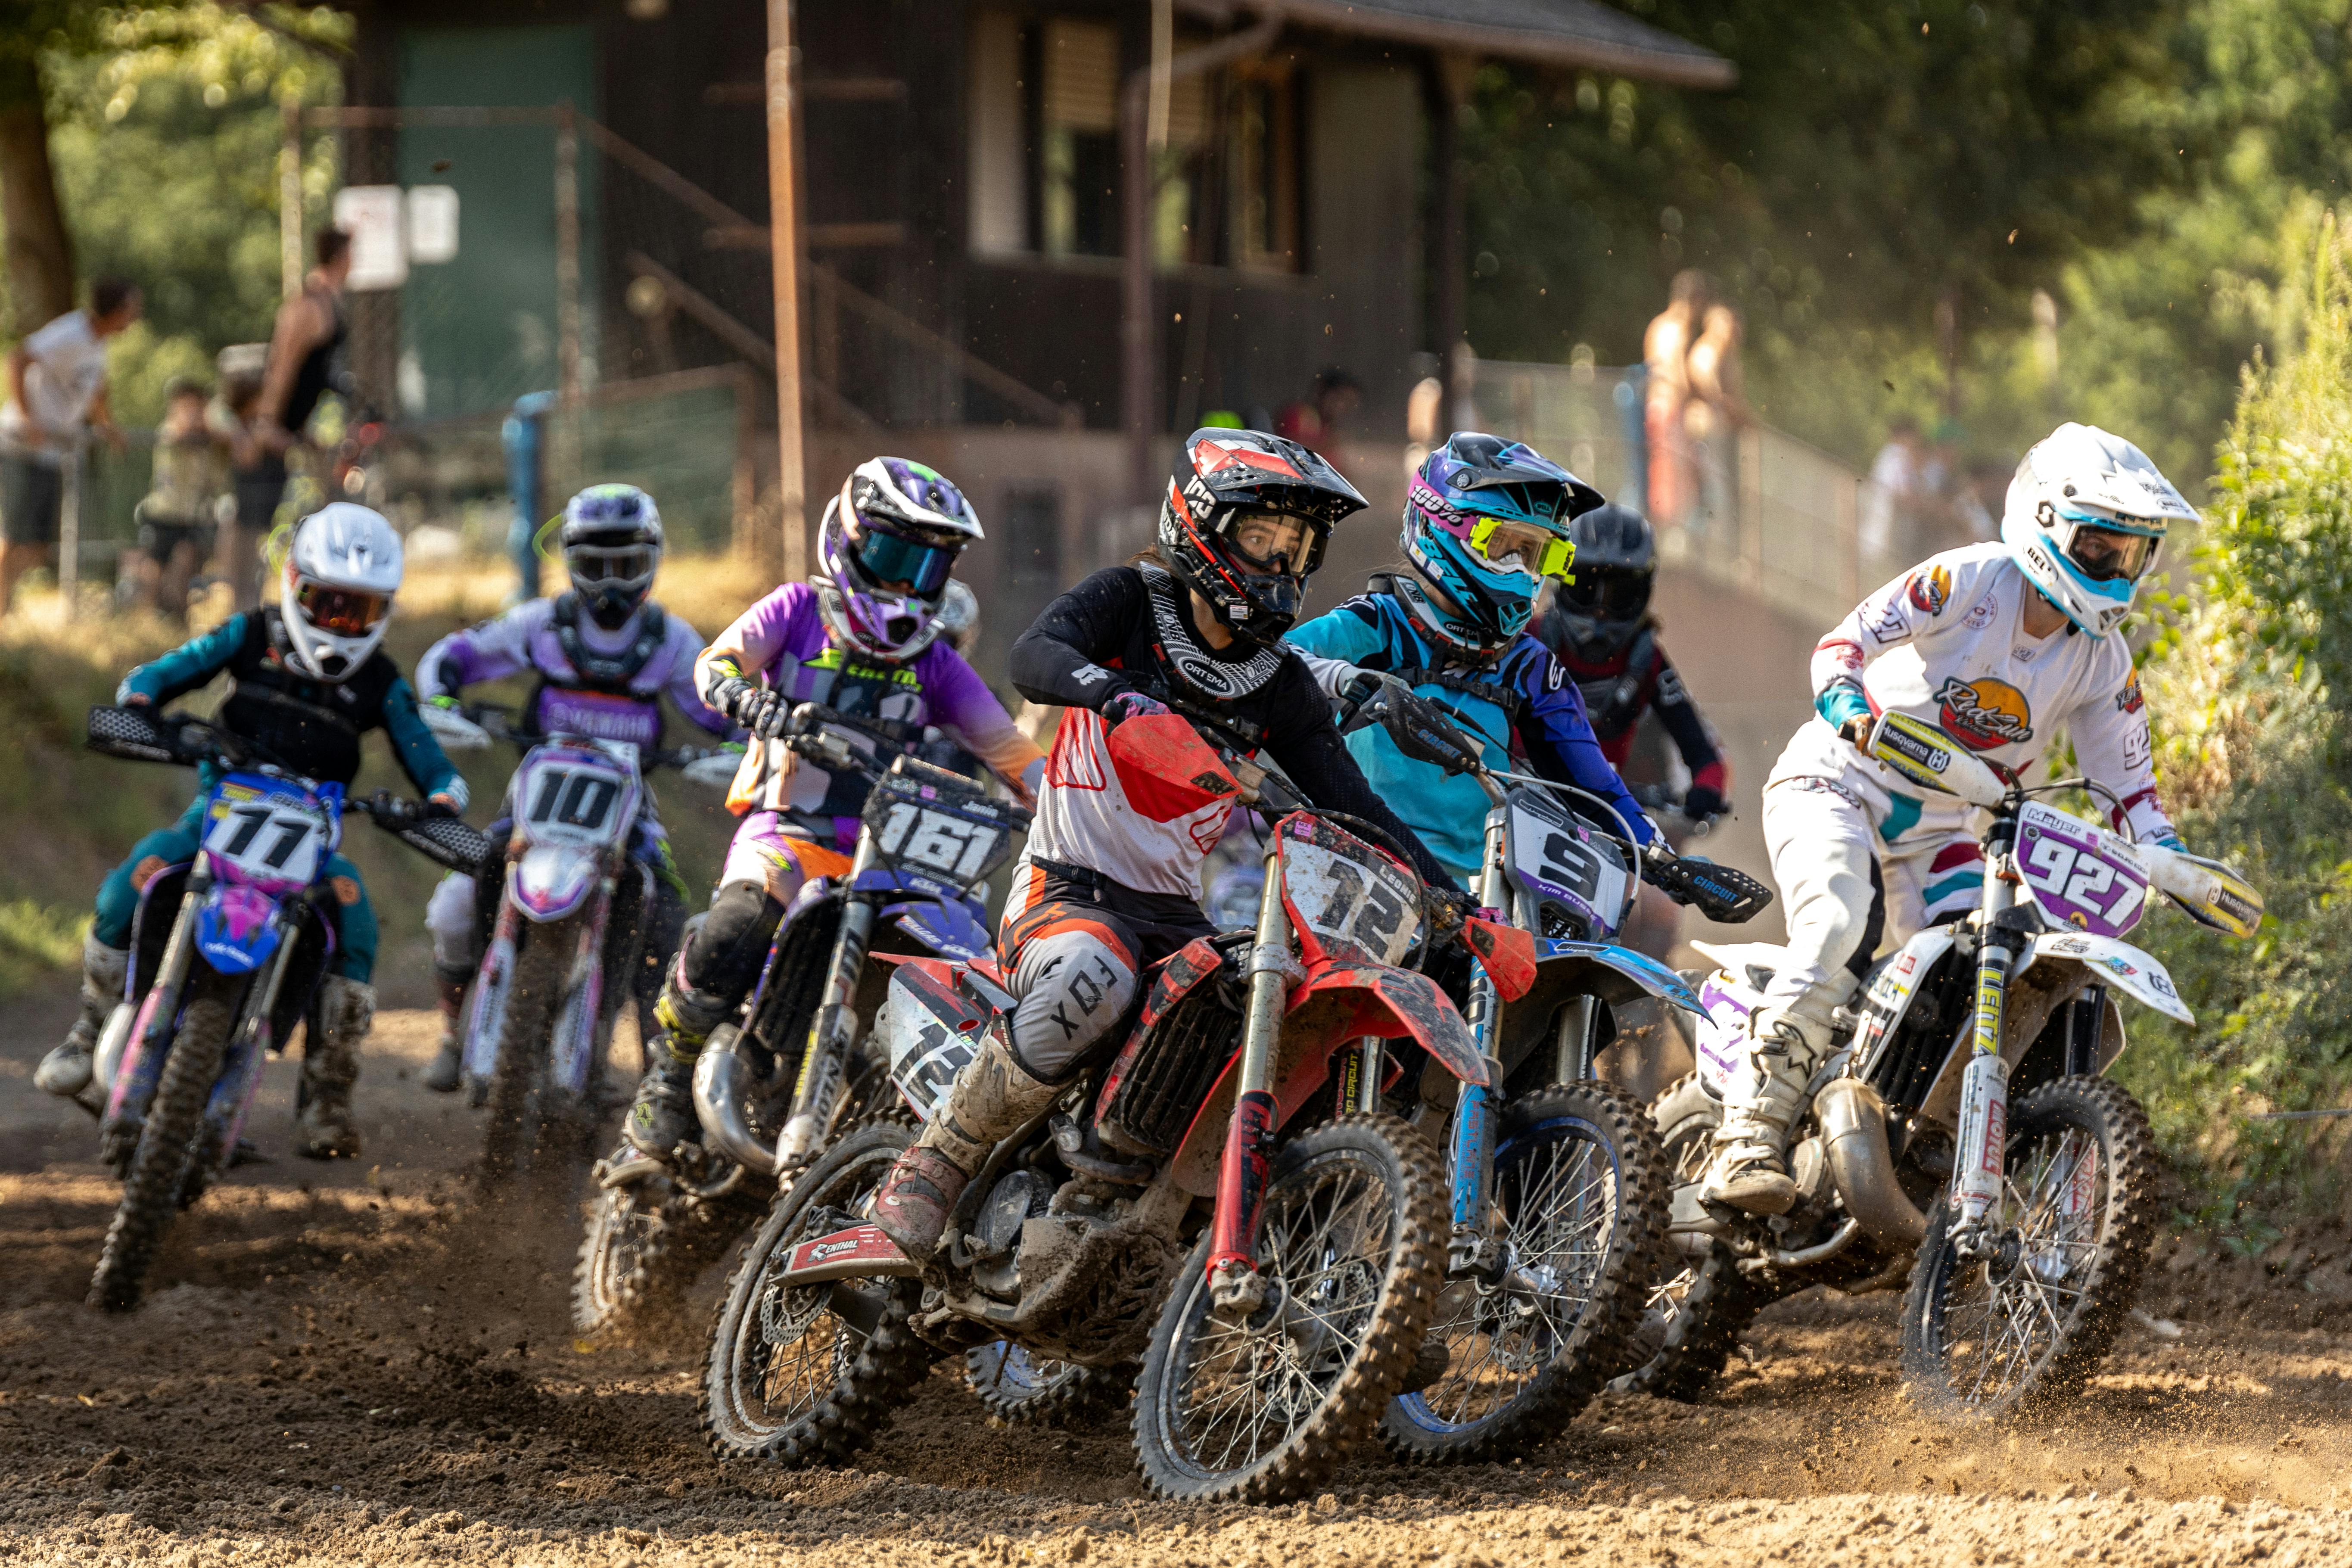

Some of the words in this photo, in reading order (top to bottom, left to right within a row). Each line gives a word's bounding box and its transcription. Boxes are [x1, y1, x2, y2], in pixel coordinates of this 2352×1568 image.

[1410, 485, 1464, 527] 100%
[1446, 623, 1478, 636] ORTEM
[1185, 662, 1227, 690] ORTEMA
[1248, 660, 1267, 678] ONB
[1418, 729, 1462, 759] CIRCUIT
[1882, 725, 1929, 757] Husqvarna
[2124, 720, 2150, 770] 92
[530, 772, 618, 830] 10
[2028, 807, 2081, 834] Mayer
[223, 809, 311, 869] 11
[878, 802, 1000, 880] 161
[1379, 864, 1417, 905] LEONIE
[1538, 832, 1602, 902] 9
[1538, 884, 1562, 896] KIM
[1693, 875, 1739, 903] CIRCUIT
[2024, 836, 2146, 927] 927
[1316, 859, 1403, 960] 12
[1049, 955, 1119, 1041] FOX
[1972, 967, 2005, 1056] LEITZ
[892, 1022, 973, 1110] 12
[1347, 1053, 1358, 1098] CIRCUIT
[1463, 1099, 1481, 1181] FASTLANE
[1984, 1101, 2006, 1175] MOTUL
[810, 1239, 859, 1261] RENTHAL
